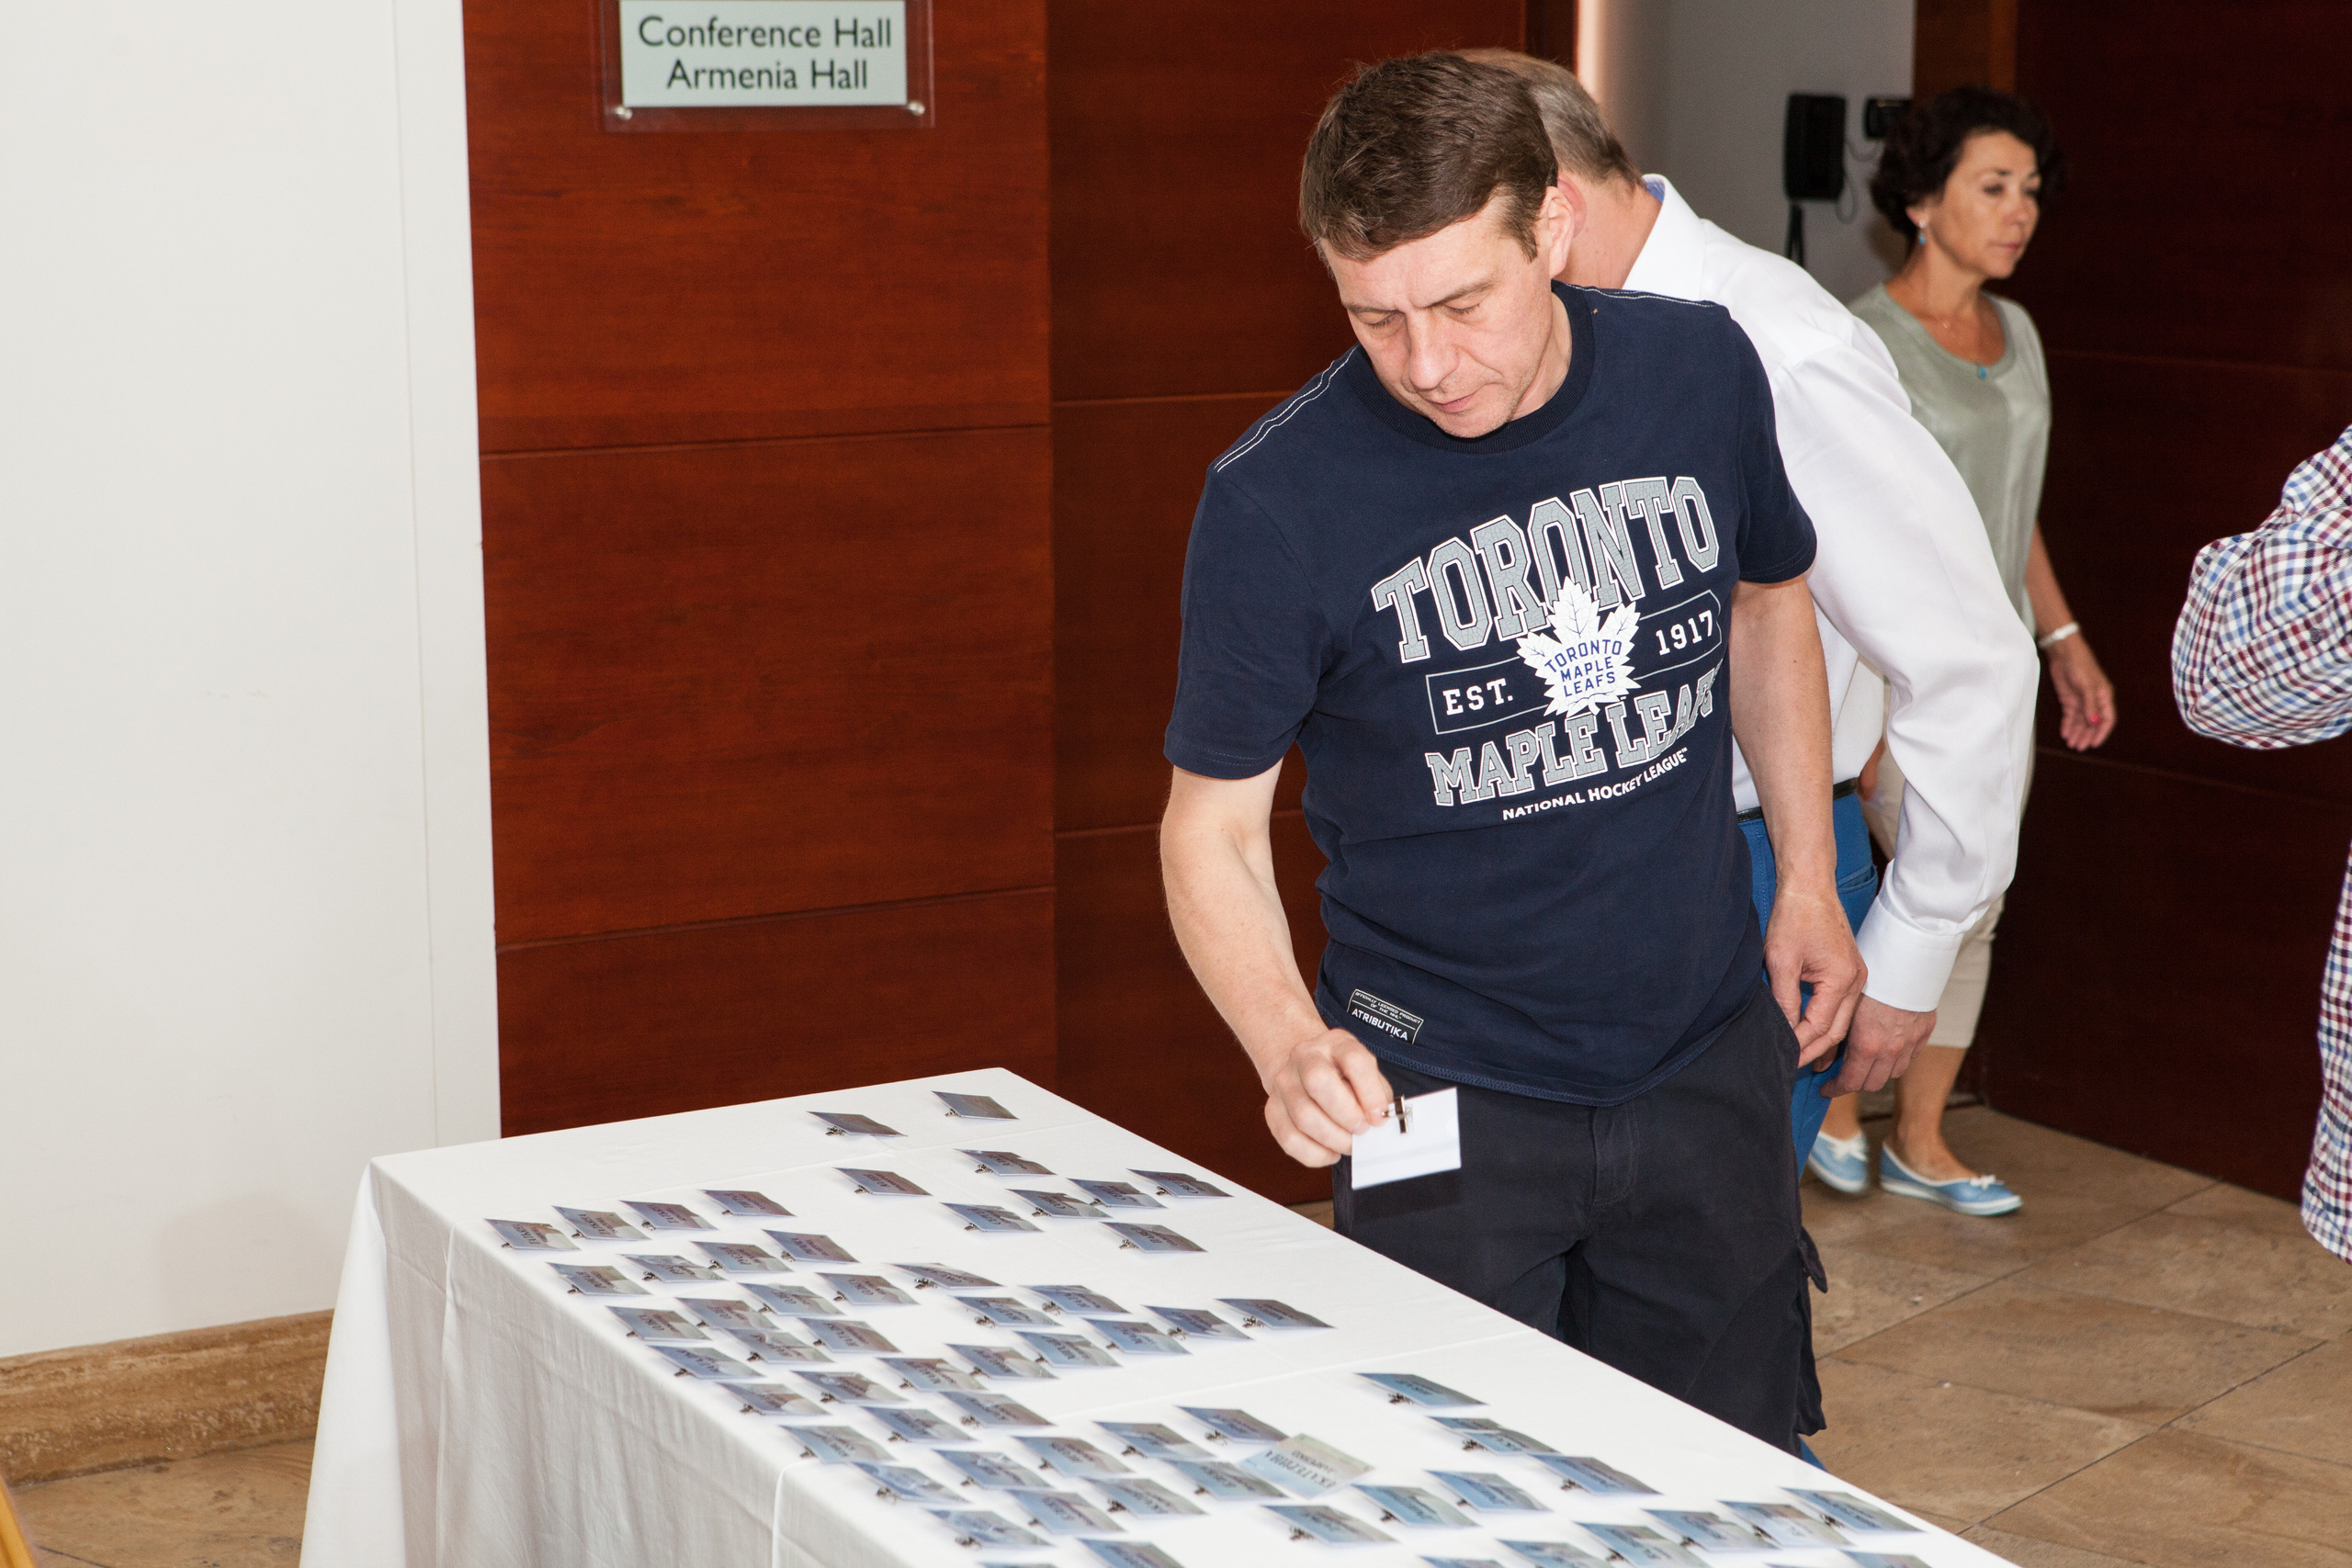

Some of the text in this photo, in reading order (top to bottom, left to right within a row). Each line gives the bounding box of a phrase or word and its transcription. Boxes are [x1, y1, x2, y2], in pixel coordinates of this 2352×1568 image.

[639, 16, 892, 48] Conference Hall
[667, 59, 867, 89] Armenia Hall
[1371, 476, 1720, 664] TORONTO
[1656, 610, 1714, 656] 1917
[1544, 639, 1623, 672] TORONTO
[1560, 656, 1613, 682] MAPLE
[1442, 678, 1514, 716] EST.
[1564, 671, 1615, 697] LEAFS
[1424, 713, 1608, 807] MAPLE
[1502, 792, 1586, 820] NATIONAL
[1587, 773, 1643, 802] HOCKEY
[1351, 1008, 1408, 1041] ATRIBUTIKA
